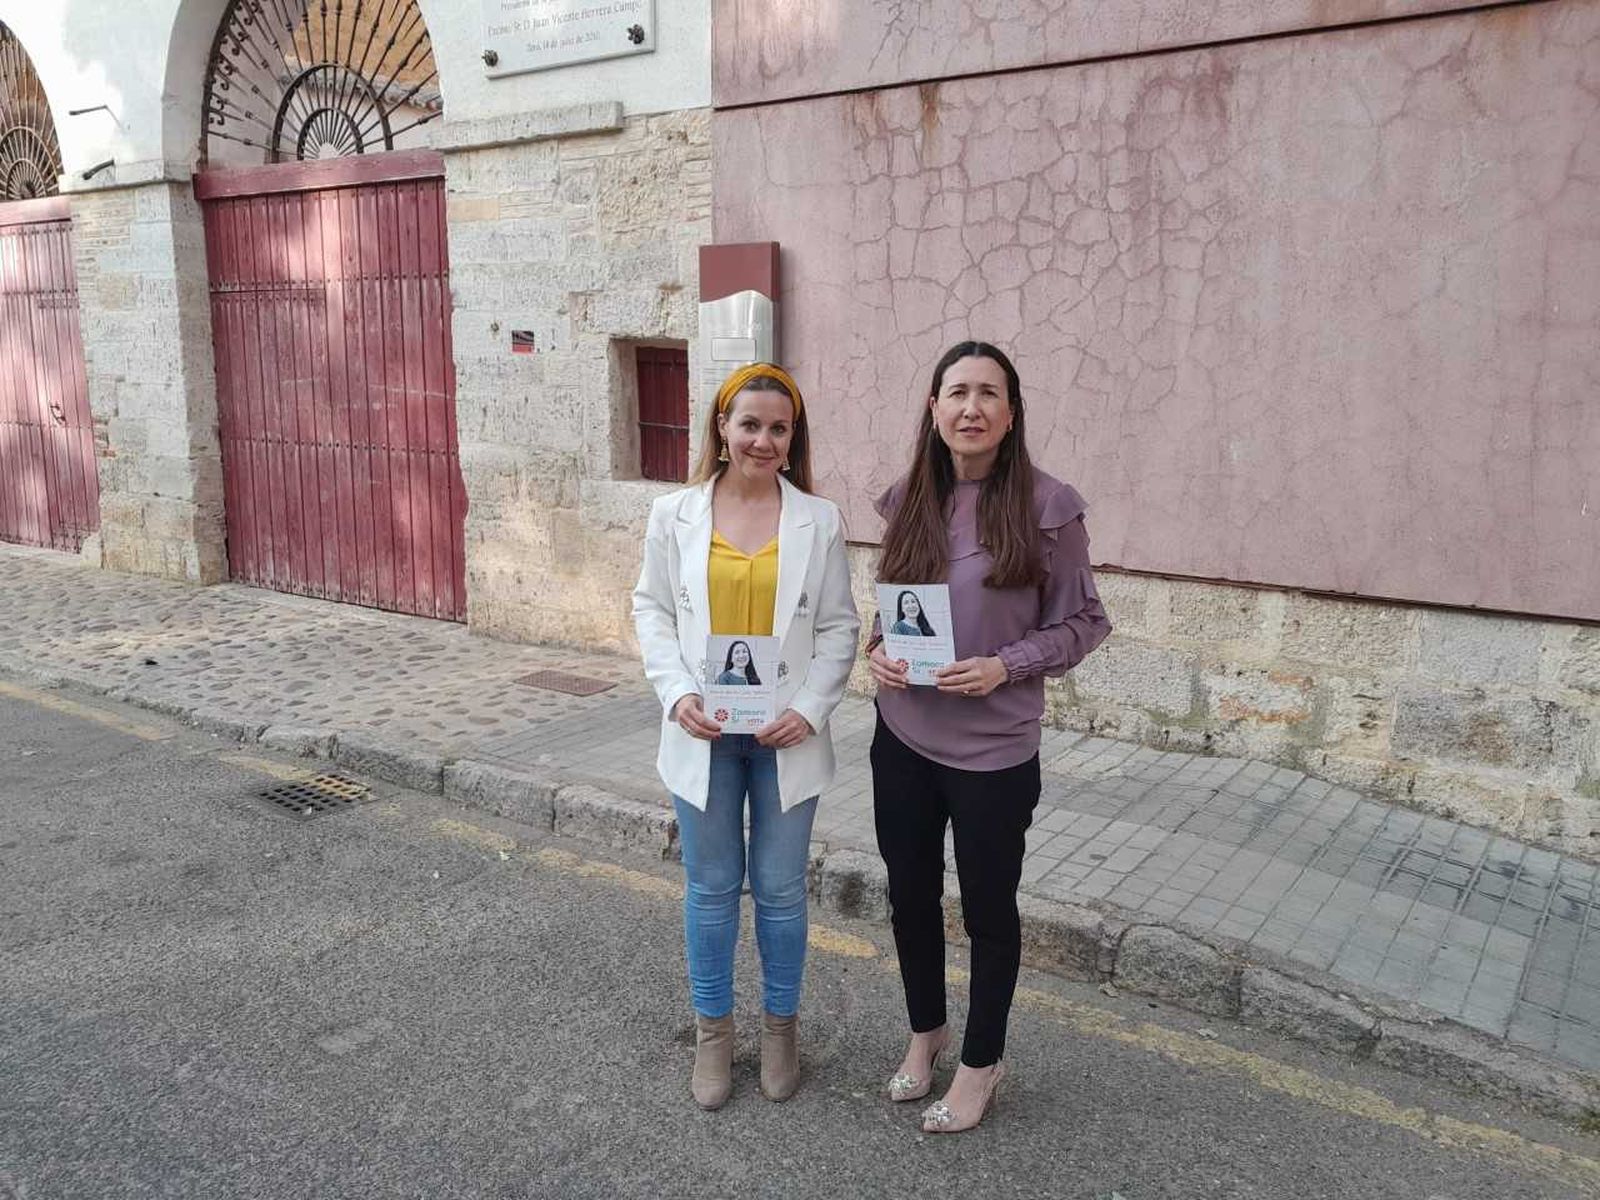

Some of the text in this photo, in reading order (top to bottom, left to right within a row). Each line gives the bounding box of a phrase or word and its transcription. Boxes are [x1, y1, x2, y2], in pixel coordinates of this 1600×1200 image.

[532, 17, 550, 30] Juan
[551, 11, 580, 26] Vicente
[580, 6, 611, 20] Herrera
[731, 708, 767, 717] Zamora
